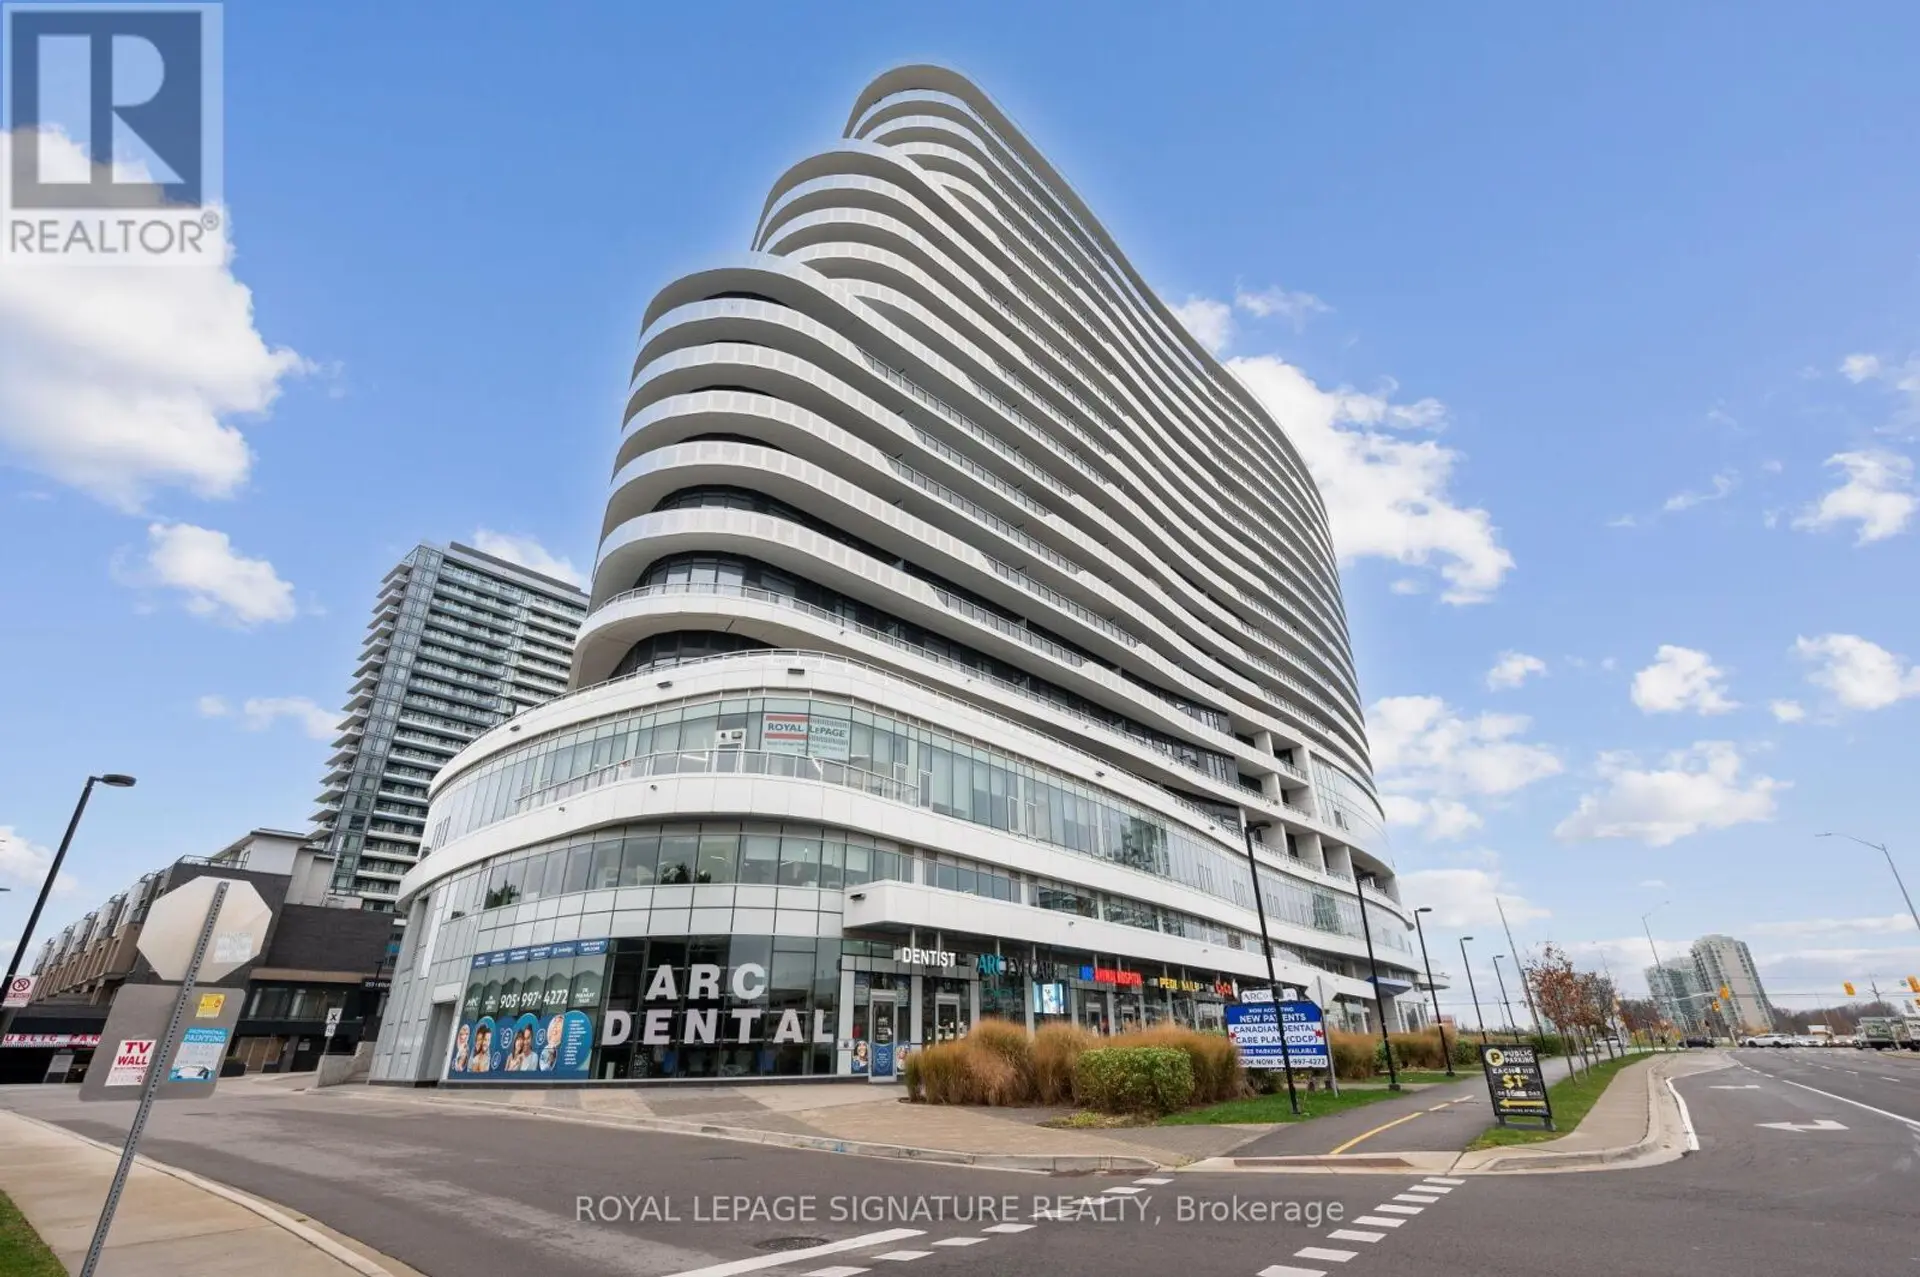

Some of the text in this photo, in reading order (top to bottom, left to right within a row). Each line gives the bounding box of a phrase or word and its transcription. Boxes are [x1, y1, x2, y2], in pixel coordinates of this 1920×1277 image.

[768, 722, 804, 732] ROYAL
[902, 947, 956, 967] DENTIST
[976, 953, 1007, 976] ARC
[645, 963, 766, 1000] ARC
[1240, 1013, 1306, 1023] NEW PATENTS
[601, 1008, 834, 1045] DENTAL
[1234, 1025, 1280, 1033] CANADIAN
[5, 1034, 57, 1042] UBLIC
[1286, 1035, 1318, 1043] (CDCP)
[125, 1042, 153, 1054] TV
[117, 1056, 148, 1065] WALL
